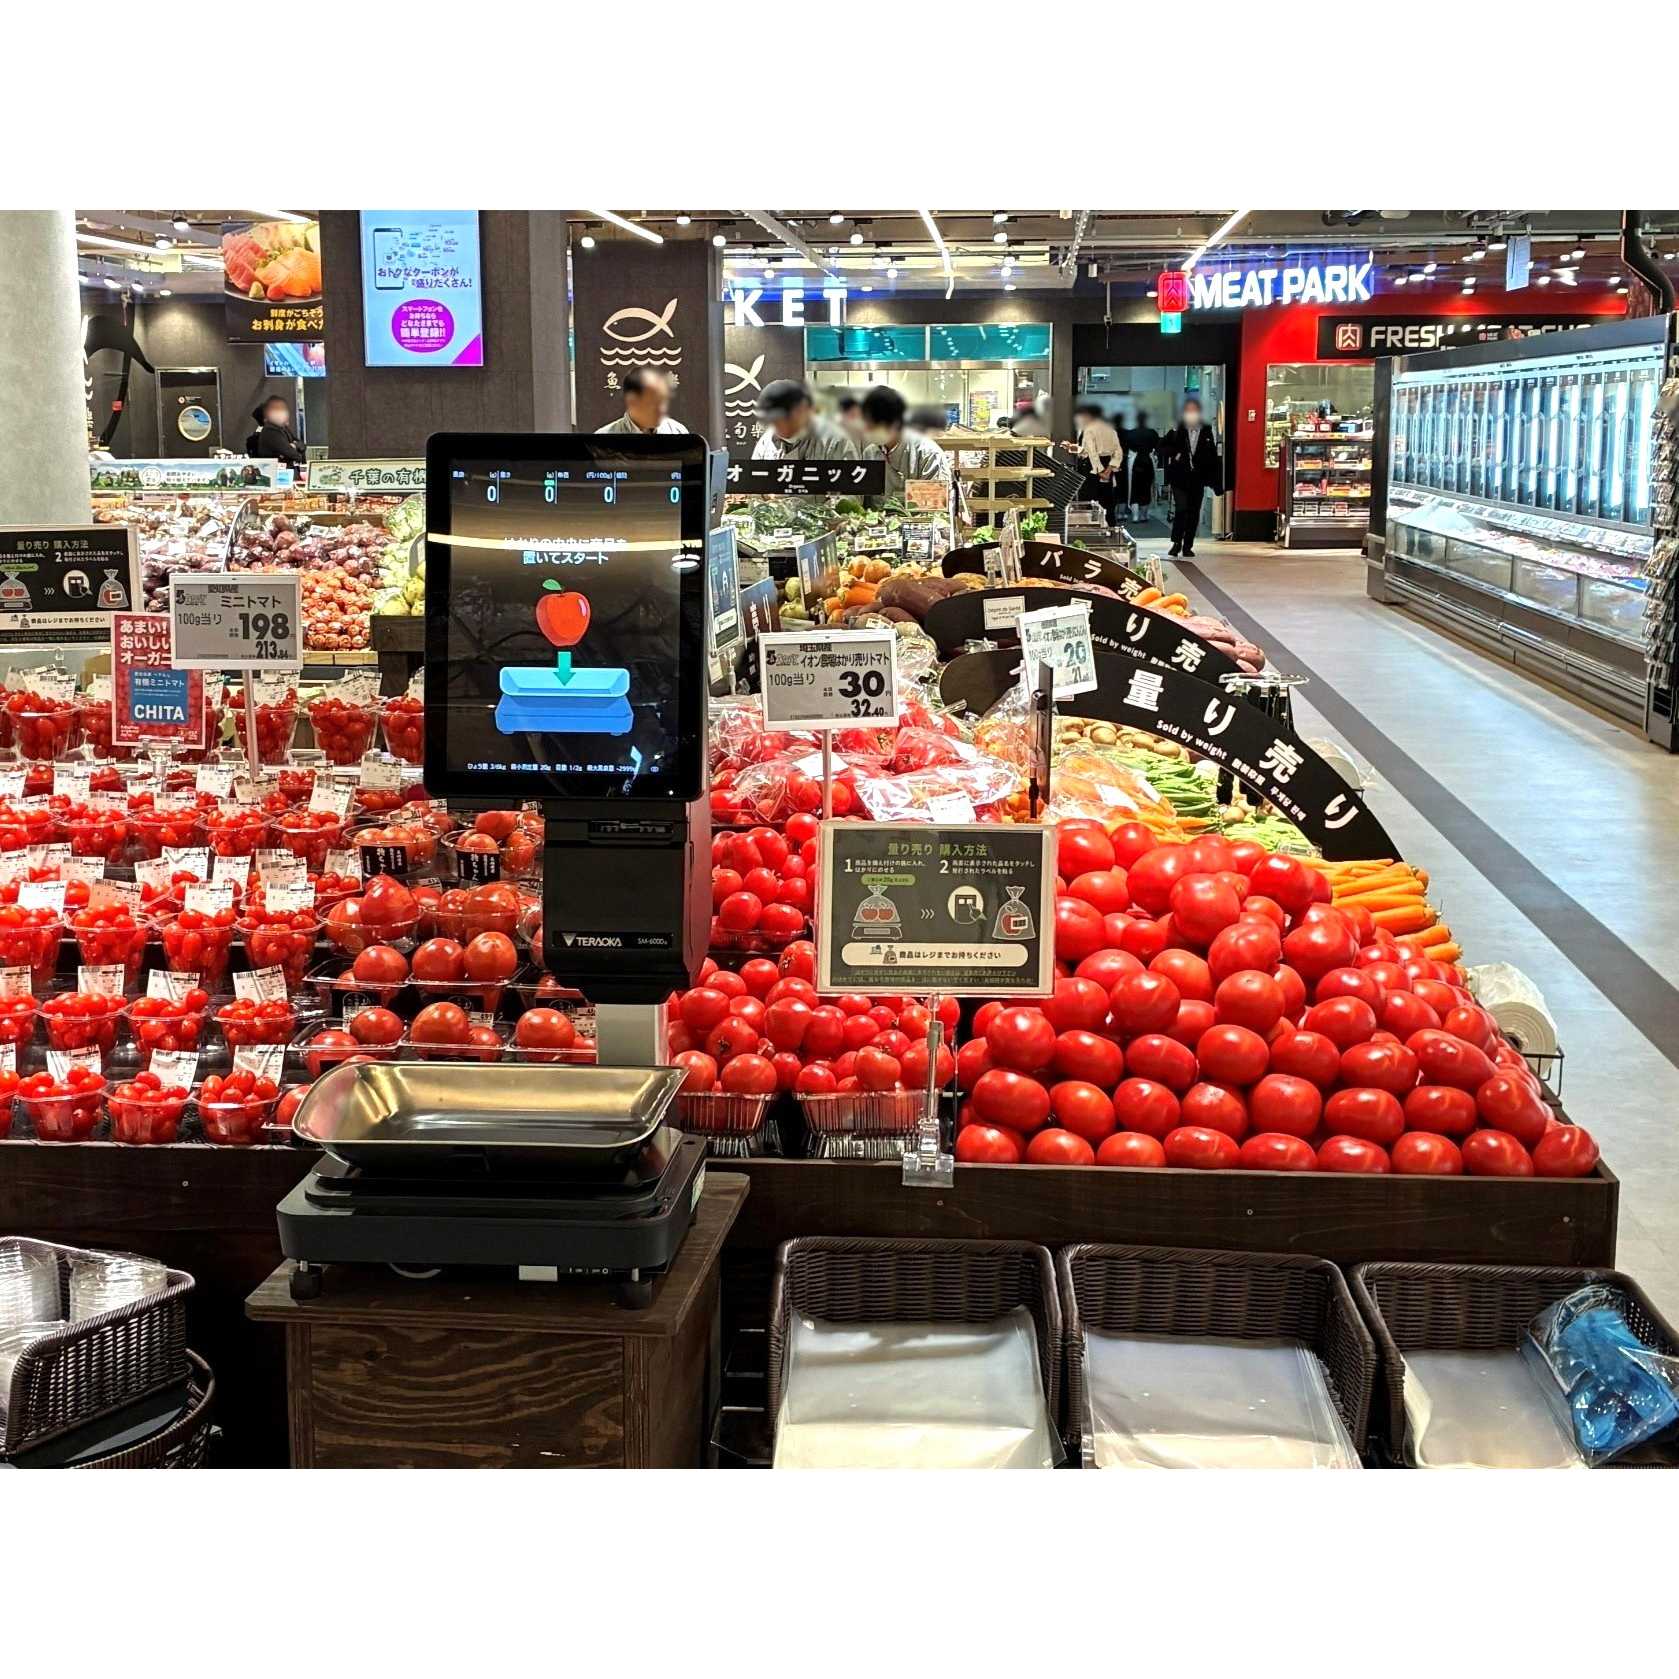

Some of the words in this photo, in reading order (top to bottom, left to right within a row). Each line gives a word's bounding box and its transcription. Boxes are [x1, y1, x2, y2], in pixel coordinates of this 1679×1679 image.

[1193, 270, 1278, 309] MEAT
[1282, 263, 1372, 305] PARK
[726, 464, 868, 484] オーガニック
[486, 485, 497, 501] 0
[545, 486, 554, 502] 0
[604, 486, 614, 503] 0
[670, 486, 680, 503] 0
[55, 552, 63, 563] 2
[522, 551, 609, 565] 置いてスタート
[221, 595, 282, 608] ミニトマト
[178, 612, 222, 625] 100g当り
[239, 612, 290, 640] 198
[120, 619, 168, 635] あまい!
[1110, 640, 1120, 649] by
[1121, 644, 1147, 660] weight
[768, 673, 815, 687] 100g当り
[838, 670, 885, 698] 30
[134, 704, 185, 721] CHITA
[851, 699, 884, 718] 32.40
[1156, 719, 1179, 736] Sold
[1180, 729, 1194, 742] by
[1195, 733, 1229, 760] weight
[1122, 668, 1360, 830] 量り売り
[887, 843, 933, 856] 量り売り
[939, 843, 988, 857] 購入方法
[844, 858, 854, 873] 1
[939, 859, 949, 874] 2
[575, 936, 623, 947] TERAOKA
[899, 951, 1001, 960] 商品はレジまでお持ちください
